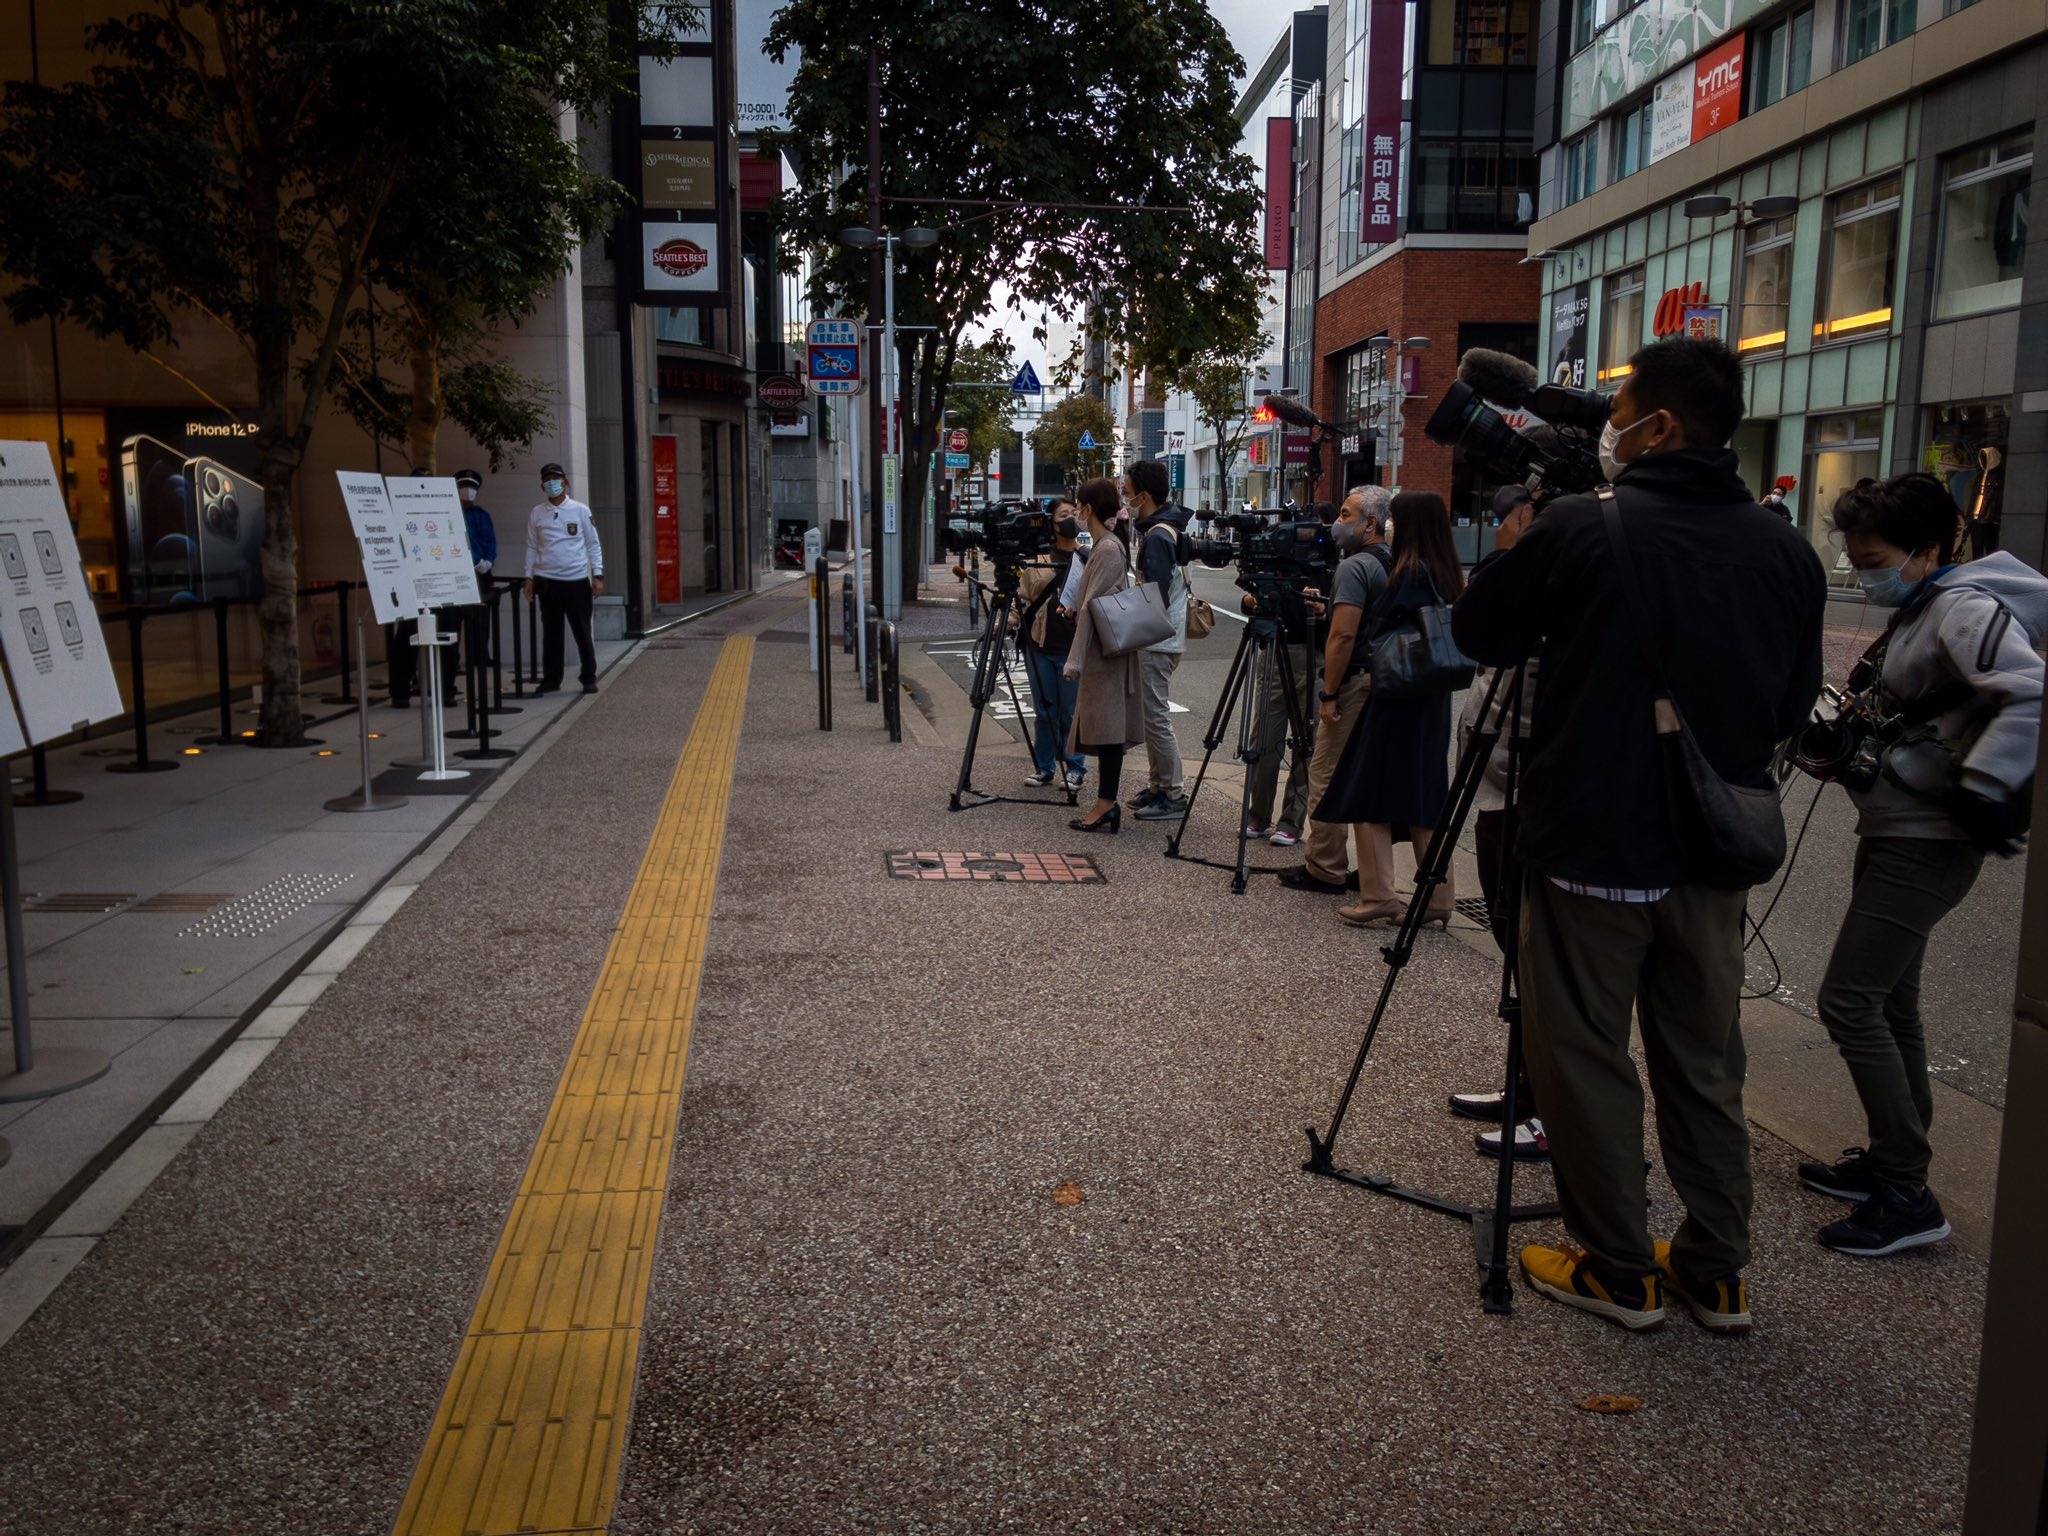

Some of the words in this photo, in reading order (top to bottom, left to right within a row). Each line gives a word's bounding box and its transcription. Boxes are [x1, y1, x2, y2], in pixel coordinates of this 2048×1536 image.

[1697, 53, 1741, 97] YMC
[1709, 107, 1720, 127] 3F
[673, 127, 682, 139] 2
[1371, 134, 1394, 225] 無印良品
[675, 210, 682, 222] 1
[1273, 205, 1282, 260] I-PRIMO
[654, 252, 688, 262] SEATTLE'S
[688, 253, 706, 263] BEST
[664, 266, 697, 276] COFFEE
[759, 387, 788, 396] SEATTLE'S
[787, 388, 803, 396] BEST
[186, 422, 230, 436] iPhone
[231, 423, 247, 436] 12
